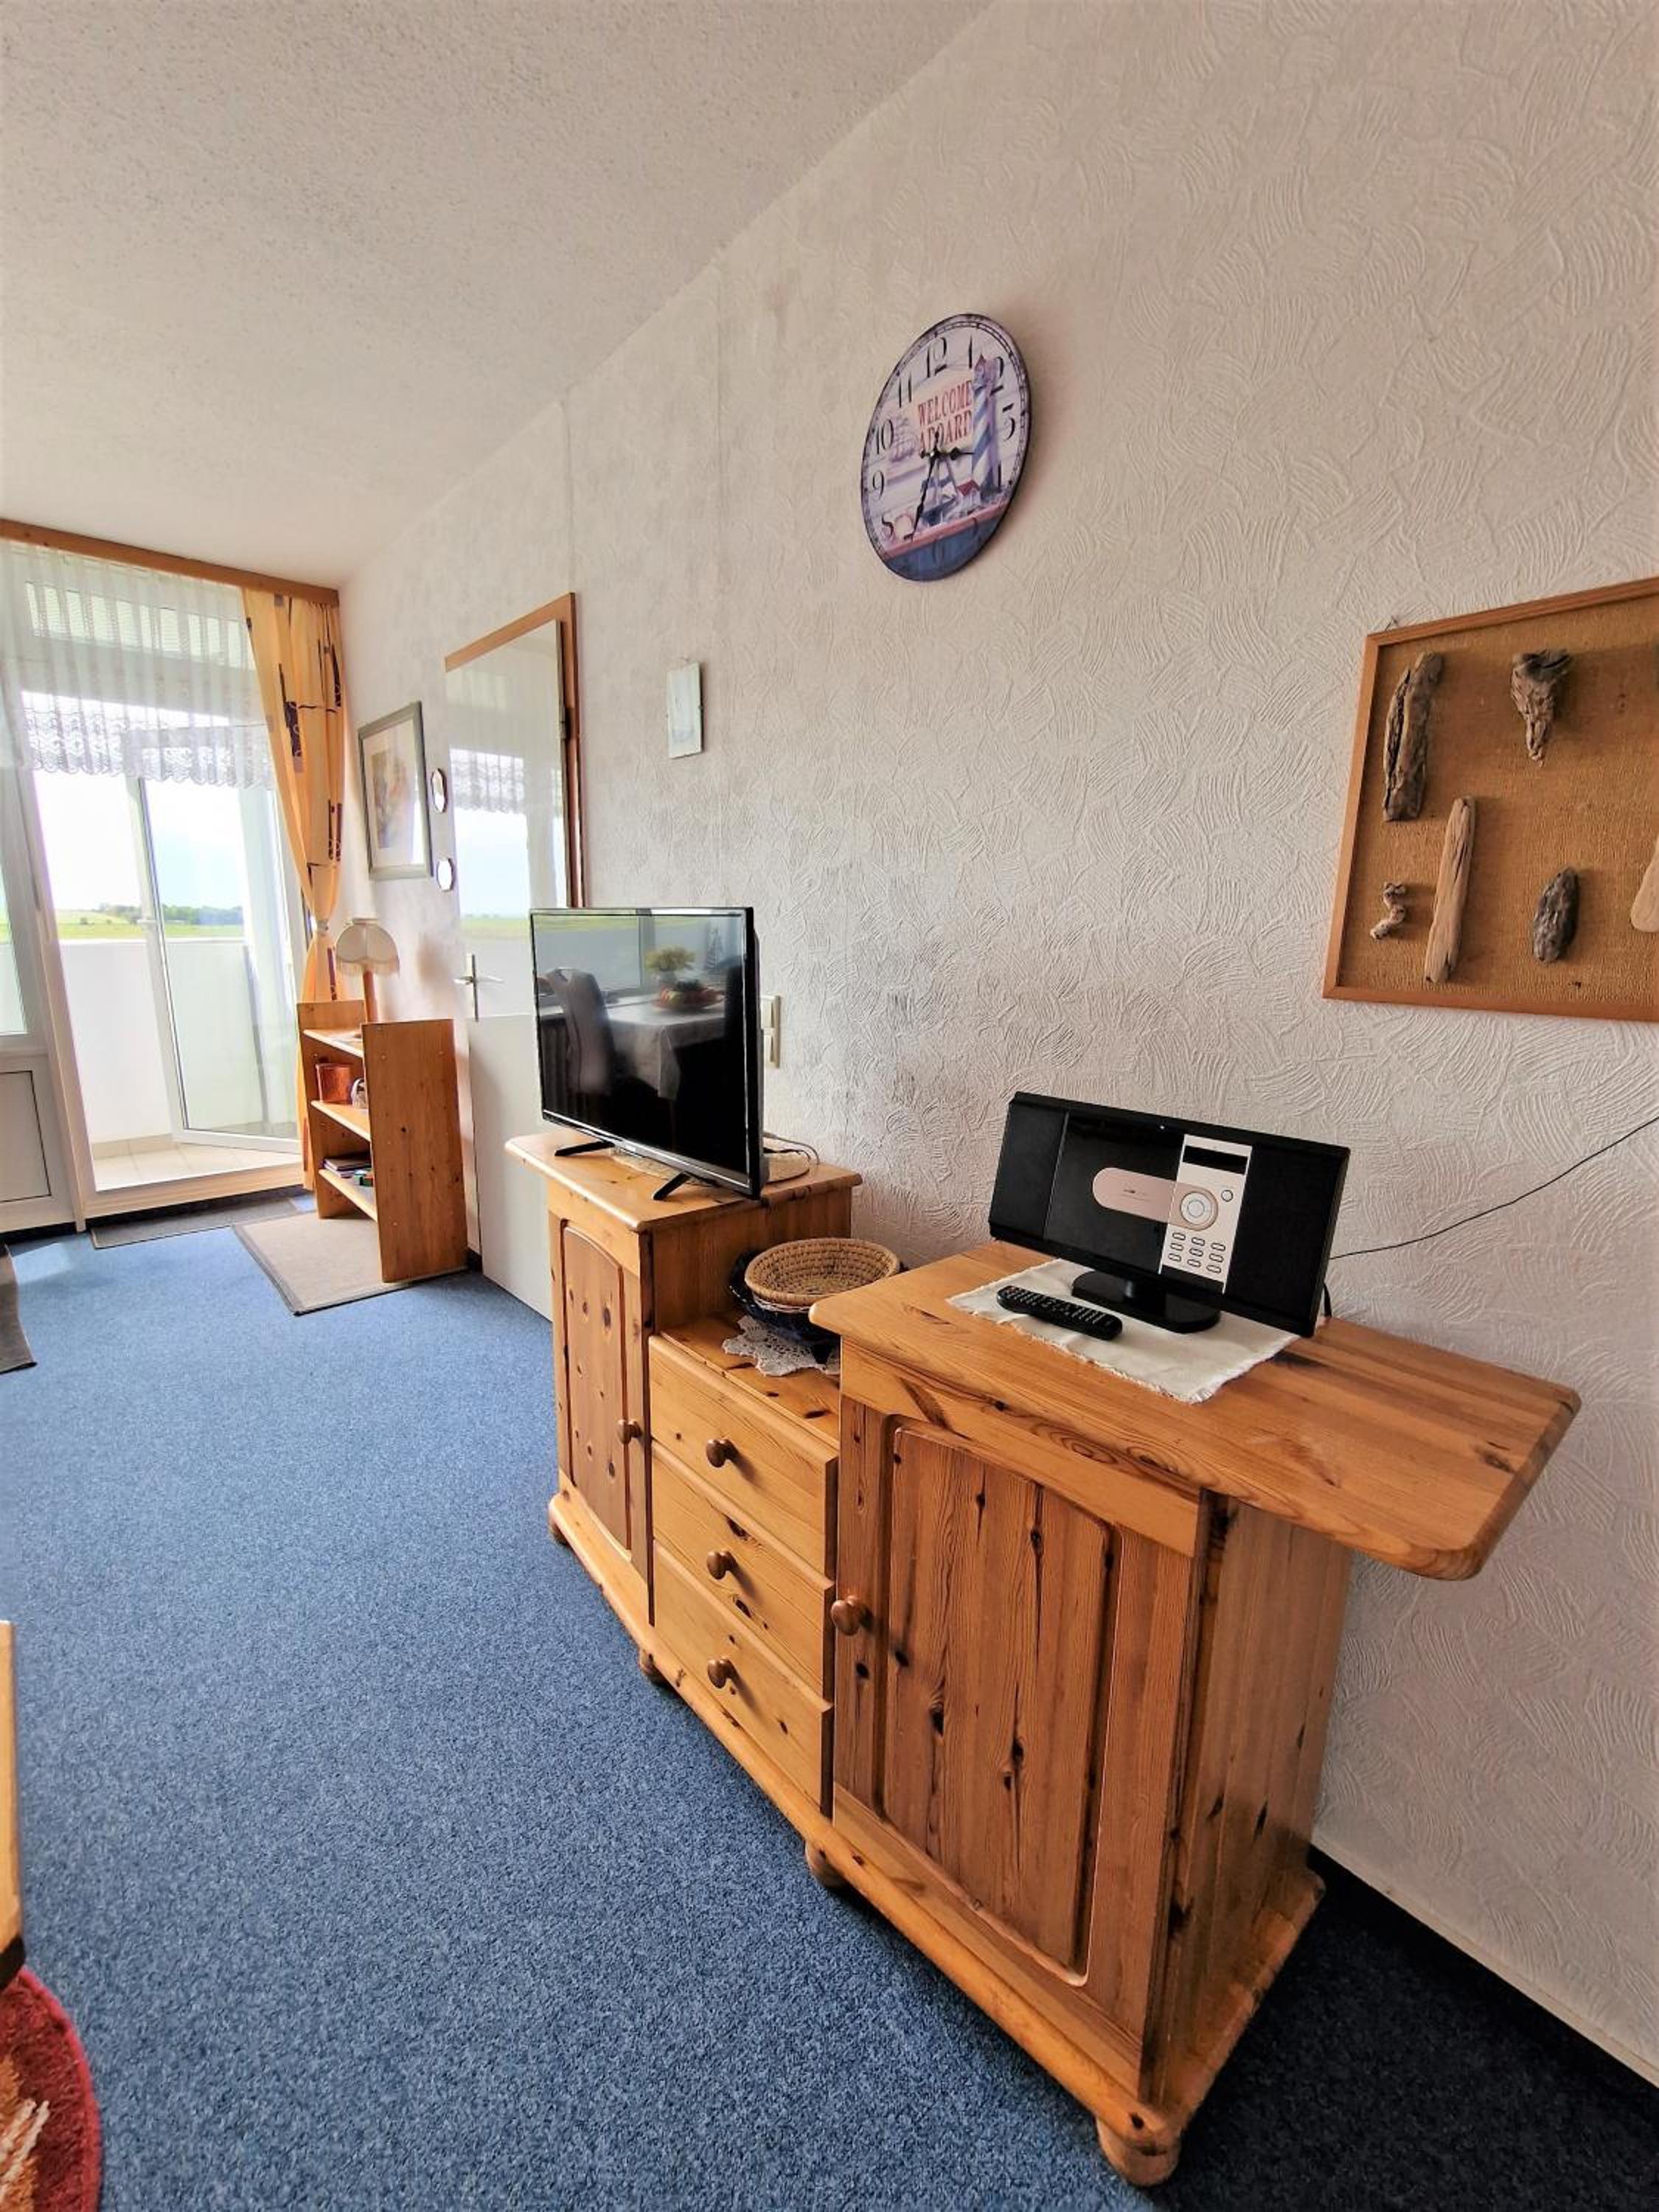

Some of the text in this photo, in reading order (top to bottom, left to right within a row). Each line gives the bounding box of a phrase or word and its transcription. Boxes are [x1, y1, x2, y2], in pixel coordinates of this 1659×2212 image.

[927, 338, 947, 378] 12
[897, 373, 912, 408] 11
[918, 380, 972, 426] WELCOME
[875, 419, 894, 455] 10
[872, 470, 885, 501] 9
